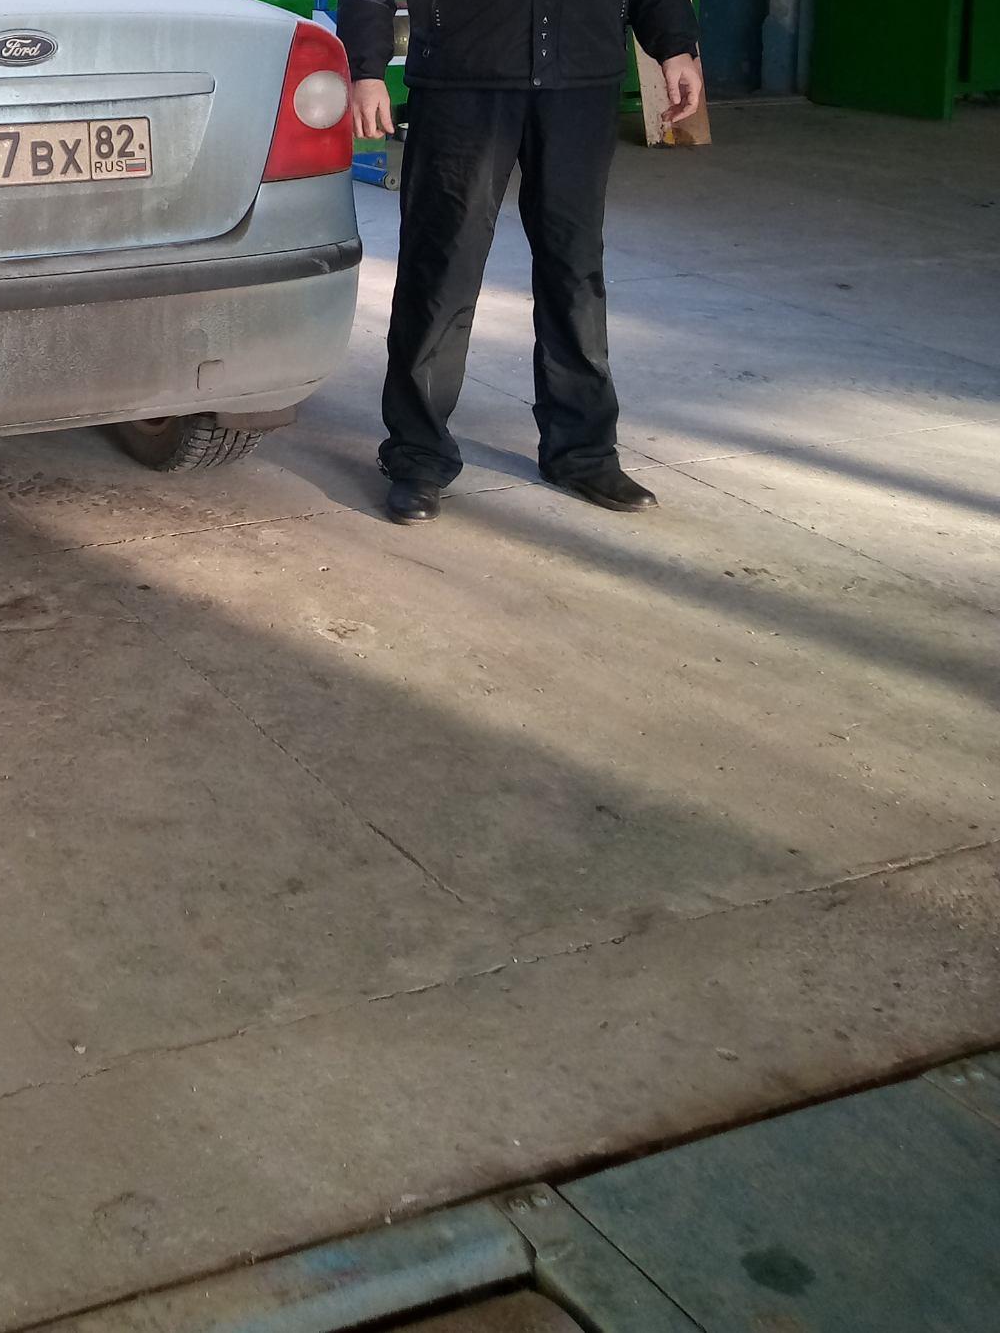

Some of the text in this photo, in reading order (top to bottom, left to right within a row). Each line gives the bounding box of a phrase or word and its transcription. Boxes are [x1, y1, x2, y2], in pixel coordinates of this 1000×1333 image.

[2, 38, 41, 57] Ford
[95, 124, 136, 159] 82
[94, 158, 125, 174] RUS
